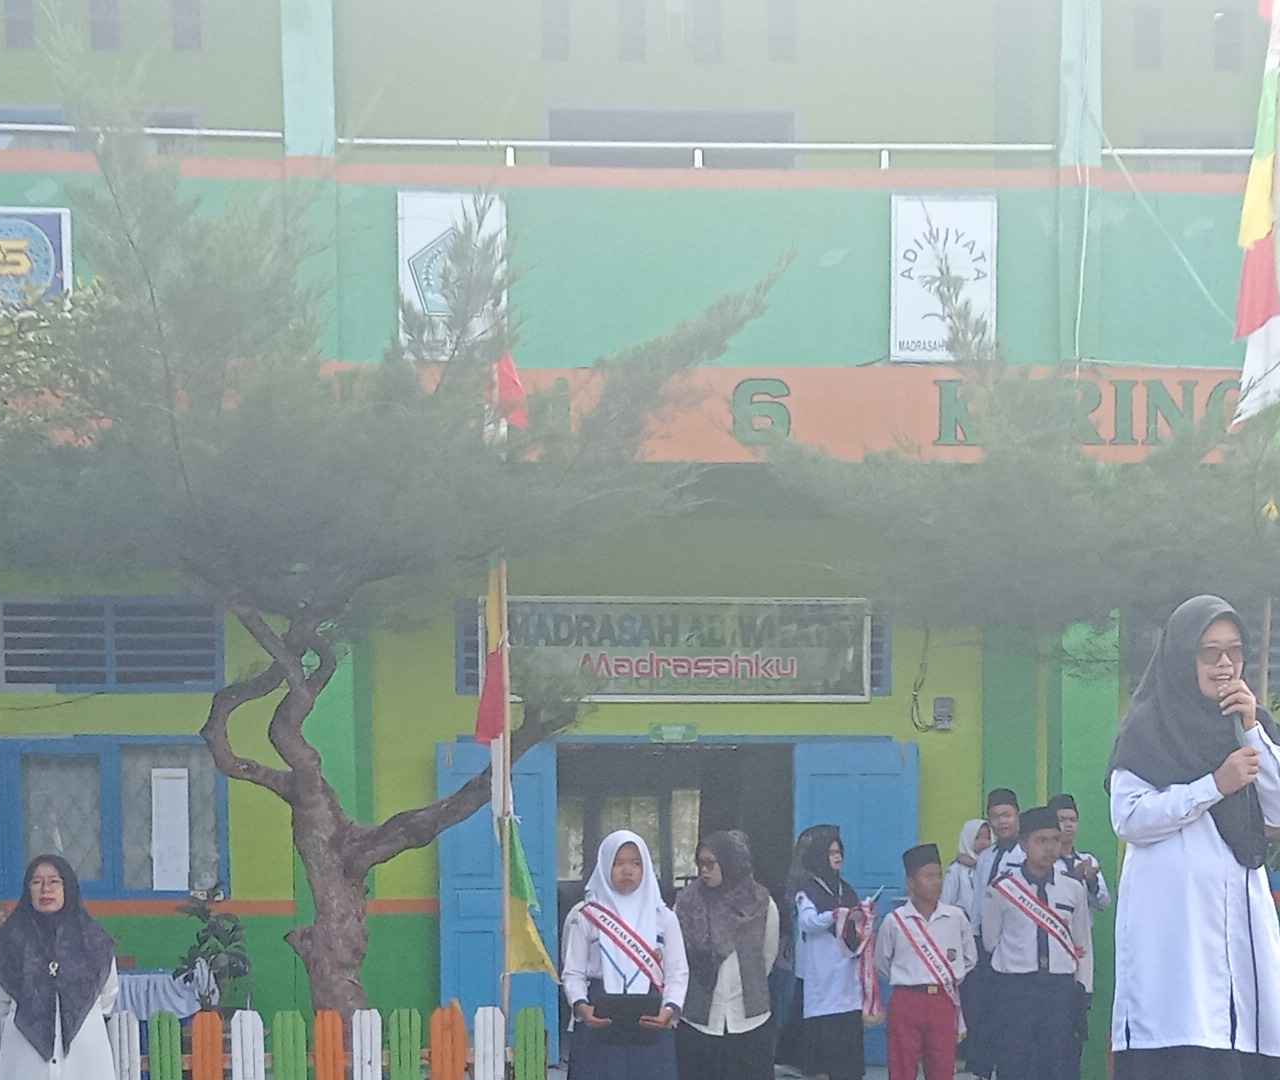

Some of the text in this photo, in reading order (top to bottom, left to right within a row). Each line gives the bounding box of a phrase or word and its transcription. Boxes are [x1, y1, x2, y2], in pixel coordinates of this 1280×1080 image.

[899, 226, 988, 282] ADIWIYATA
[730, 377, 793, 447] 6
[578, 650, 798, 680] Madrasahku
